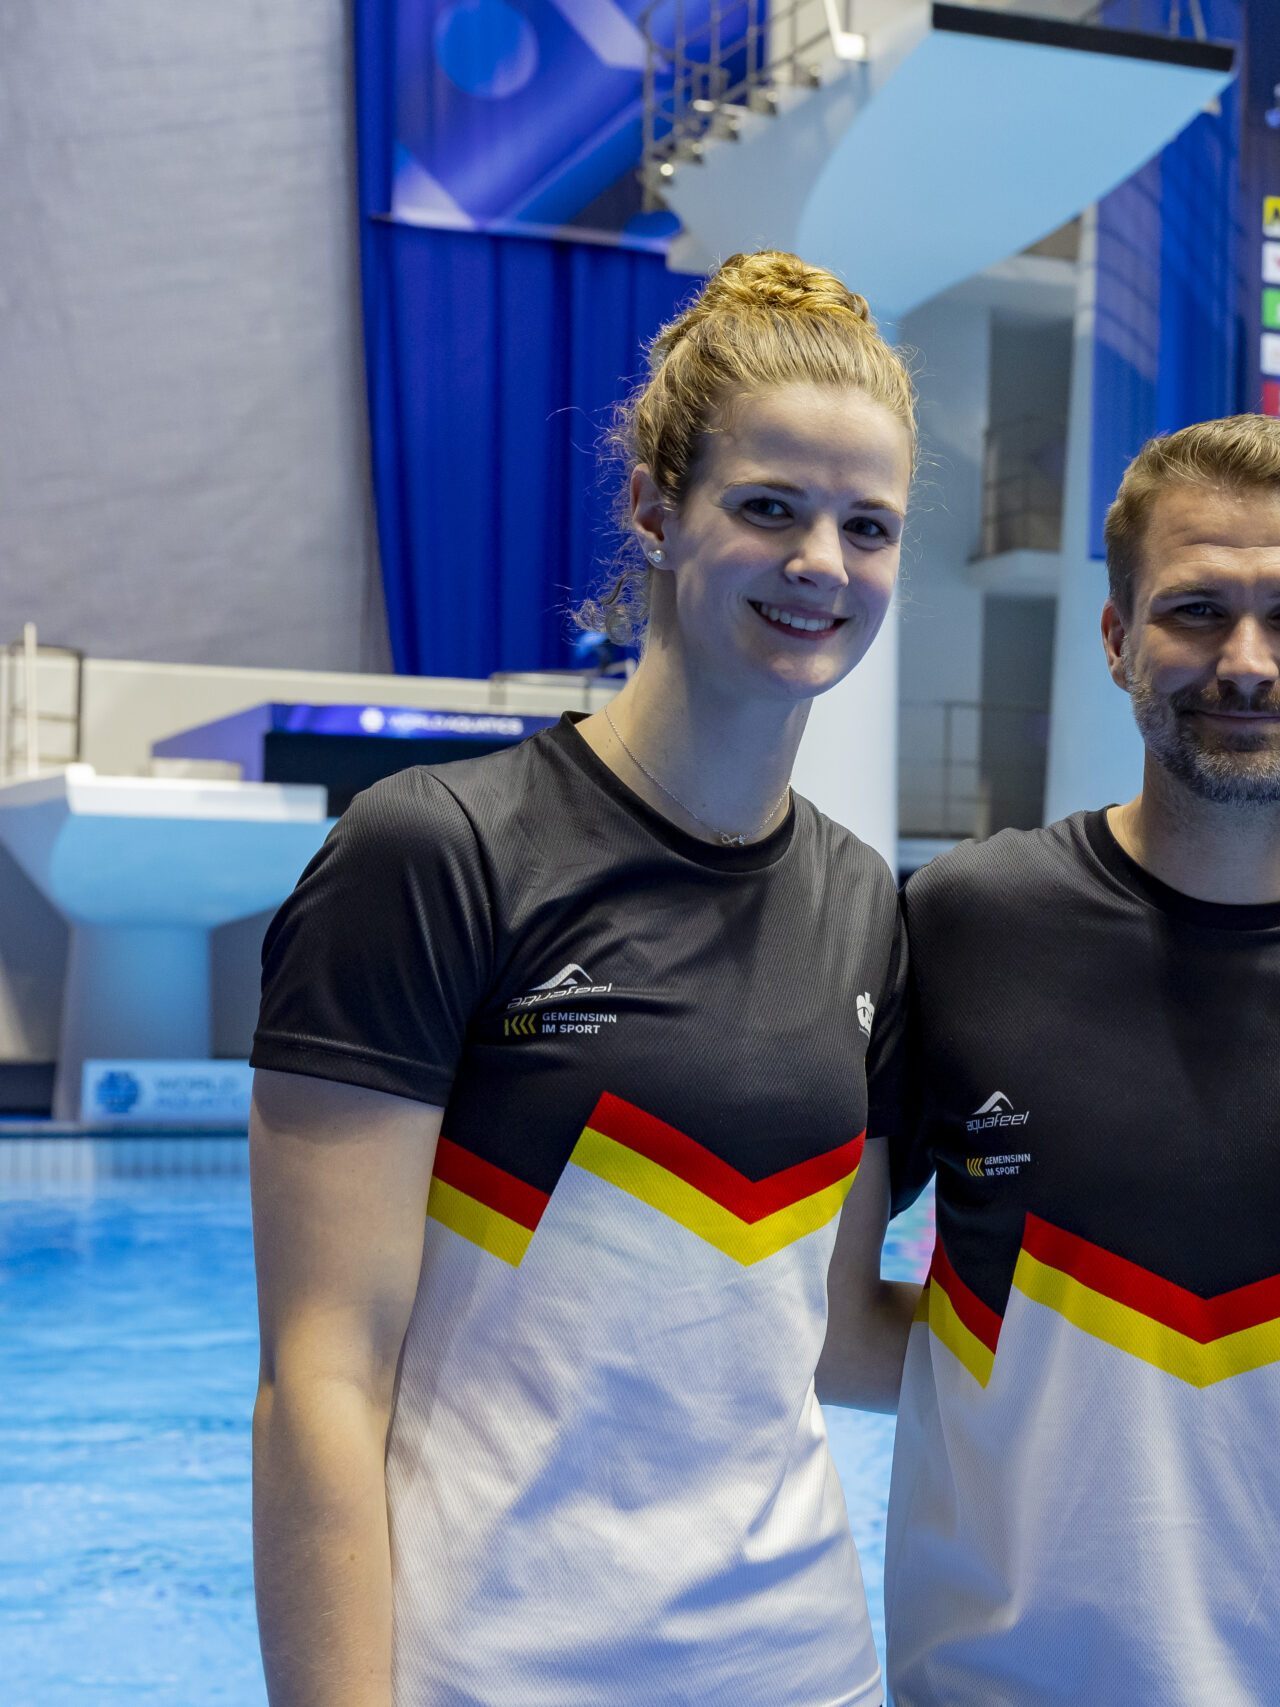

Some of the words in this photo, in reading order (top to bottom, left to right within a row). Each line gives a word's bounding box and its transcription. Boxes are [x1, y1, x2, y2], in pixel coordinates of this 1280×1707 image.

[507, 983, 612, 1009] aquafeel
[542, 1012, 617, 1023] GEMEINSINN
[542, 1024, 556, 1033] IM
[559, 1024, 601, 1034] SPORT
[966, 1110, 1030, 1134] aquafeel
[984, 1153, 1031, 1165] GEMEINSINN
[985, 1168, 995, 1176] IM
[995, 1166, 1020, 1175] SPORT
